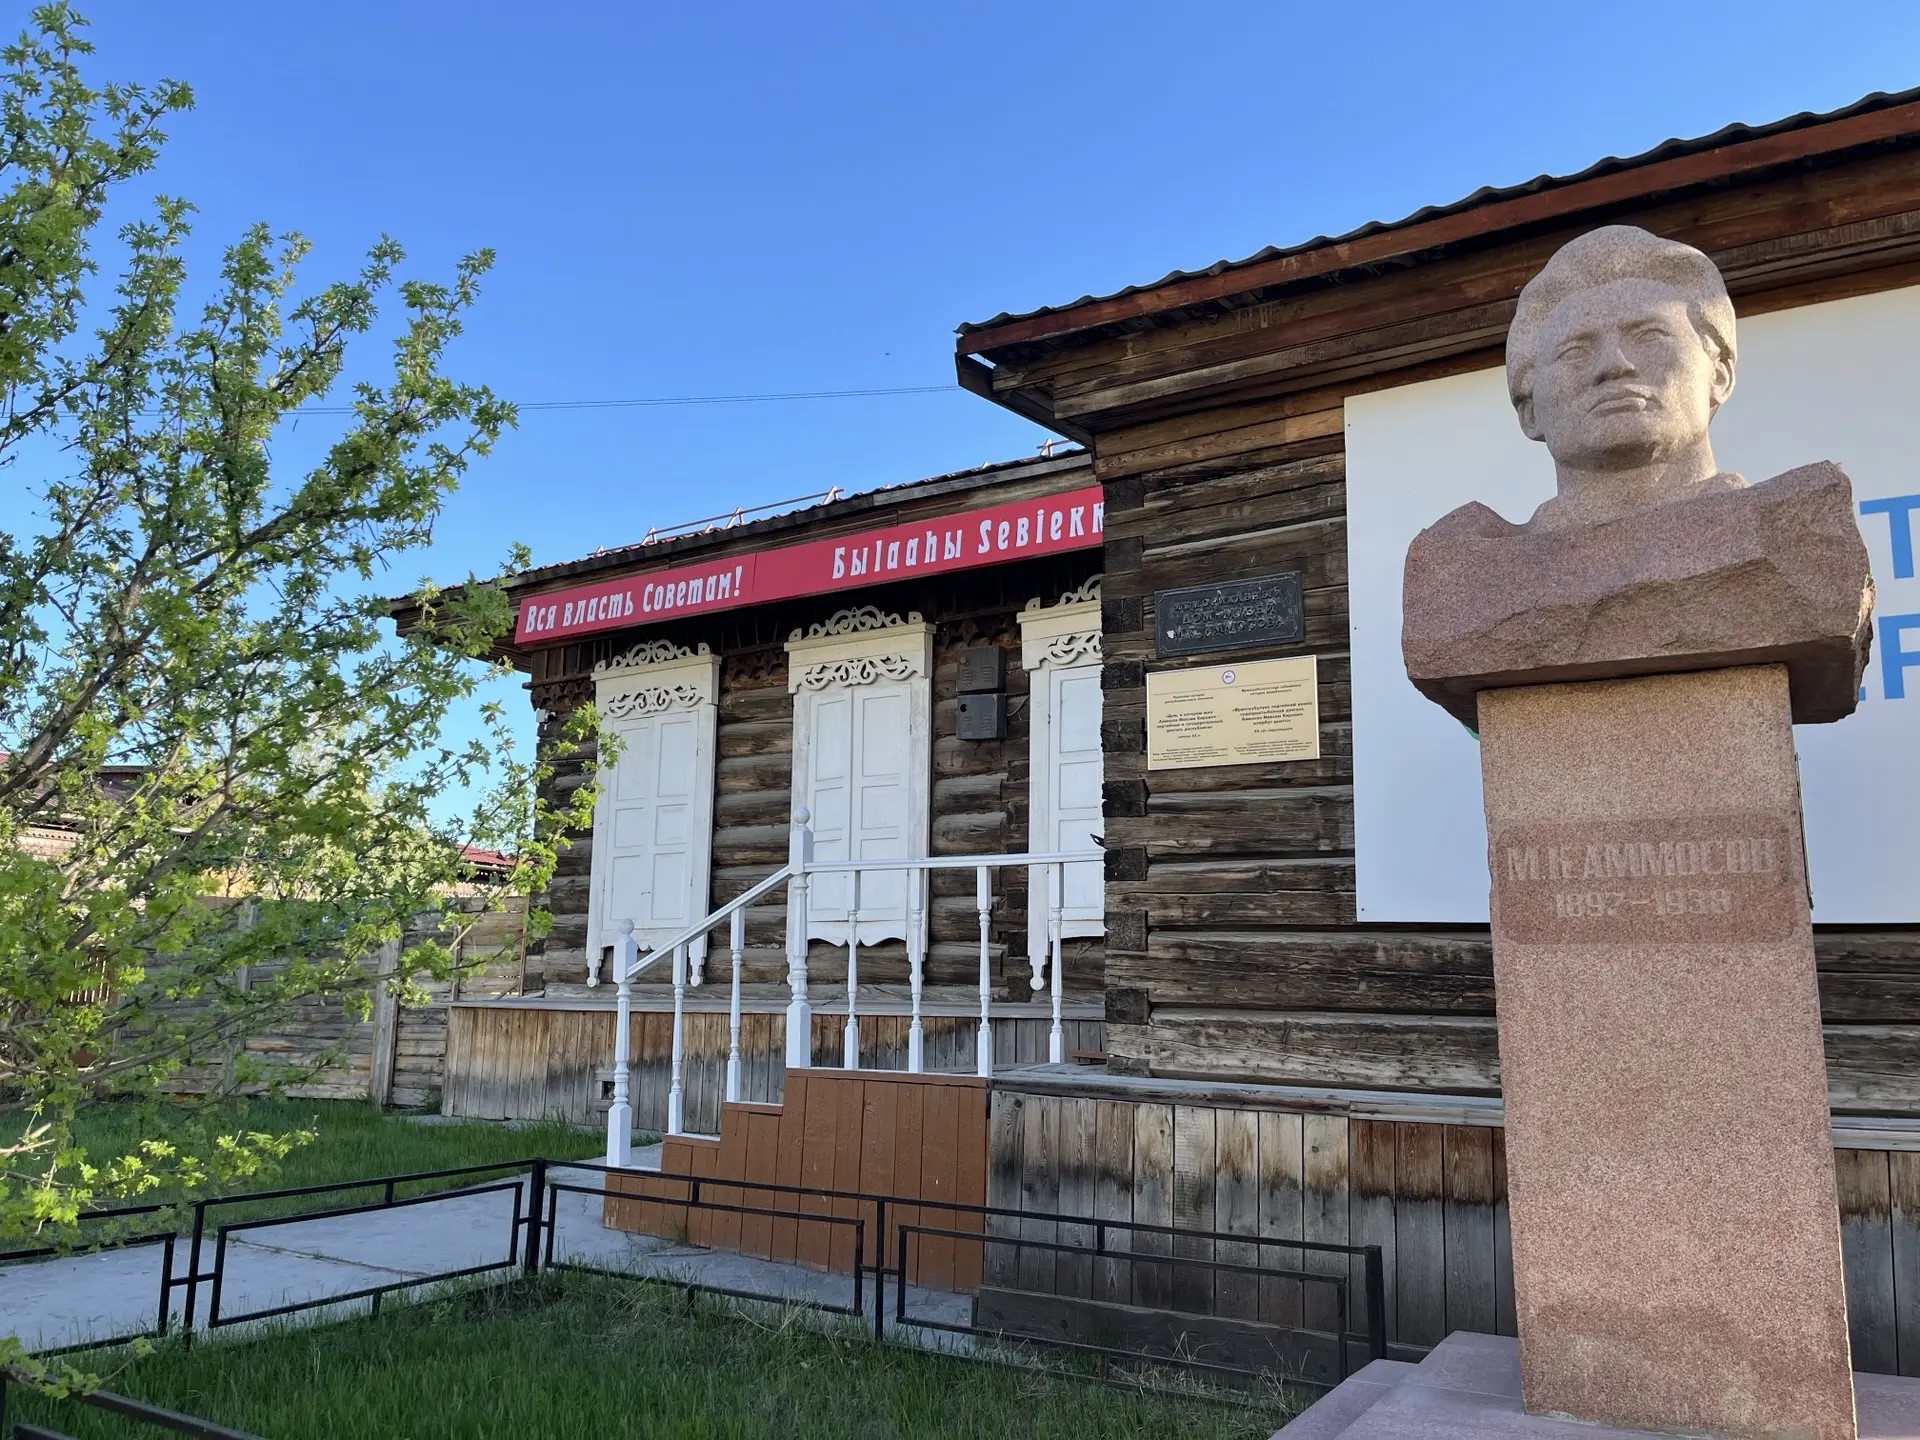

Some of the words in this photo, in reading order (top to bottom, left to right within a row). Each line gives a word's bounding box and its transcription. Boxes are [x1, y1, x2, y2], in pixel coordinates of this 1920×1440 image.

[525, 605, 557, 634] Вся
[563, 591, 634, 627] власть
[642, 565, 744, 613] Советам!
